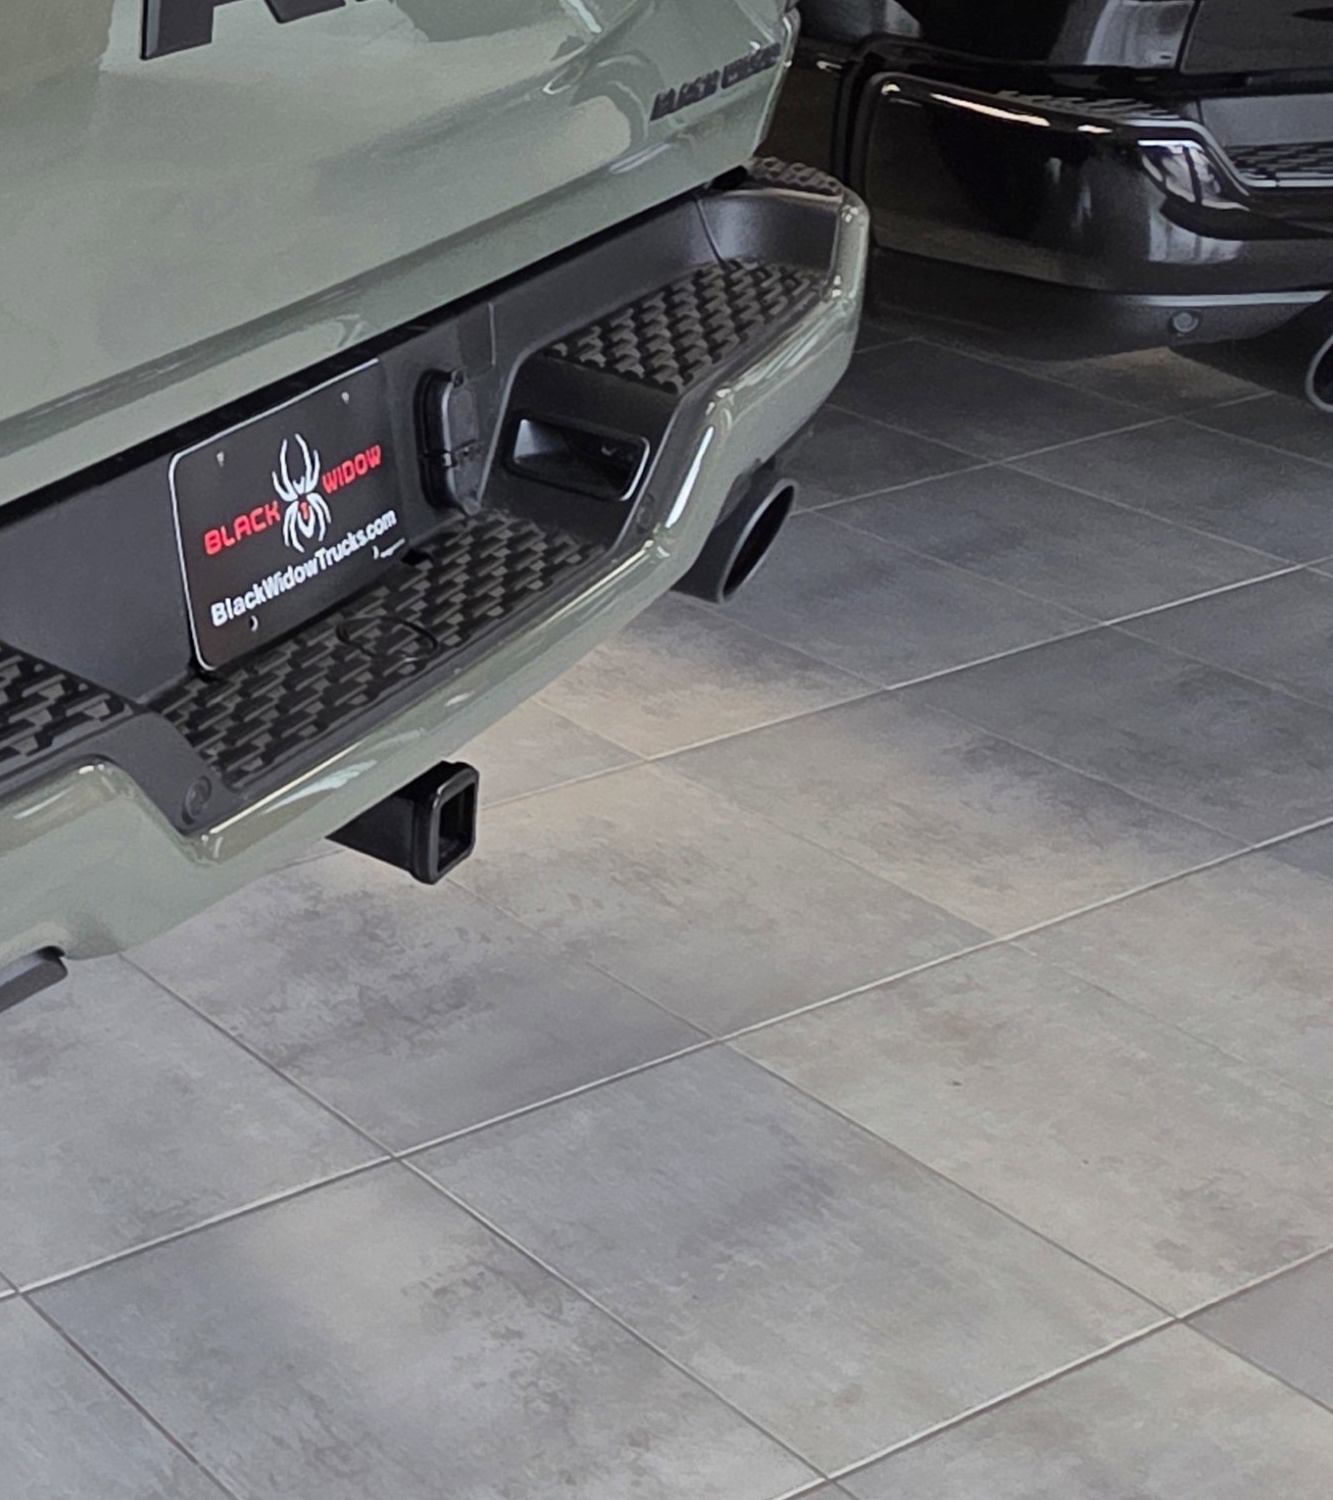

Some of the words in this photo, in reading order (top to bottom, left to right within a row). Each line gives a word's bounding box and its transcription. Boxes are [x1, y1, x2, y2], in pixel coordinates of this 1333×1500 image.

[204, 500, 282, 556] BLACK
[321, 443, 382, 495] WIDOW
[209, 509, 398, 628] BlackWidowTrucks.com
